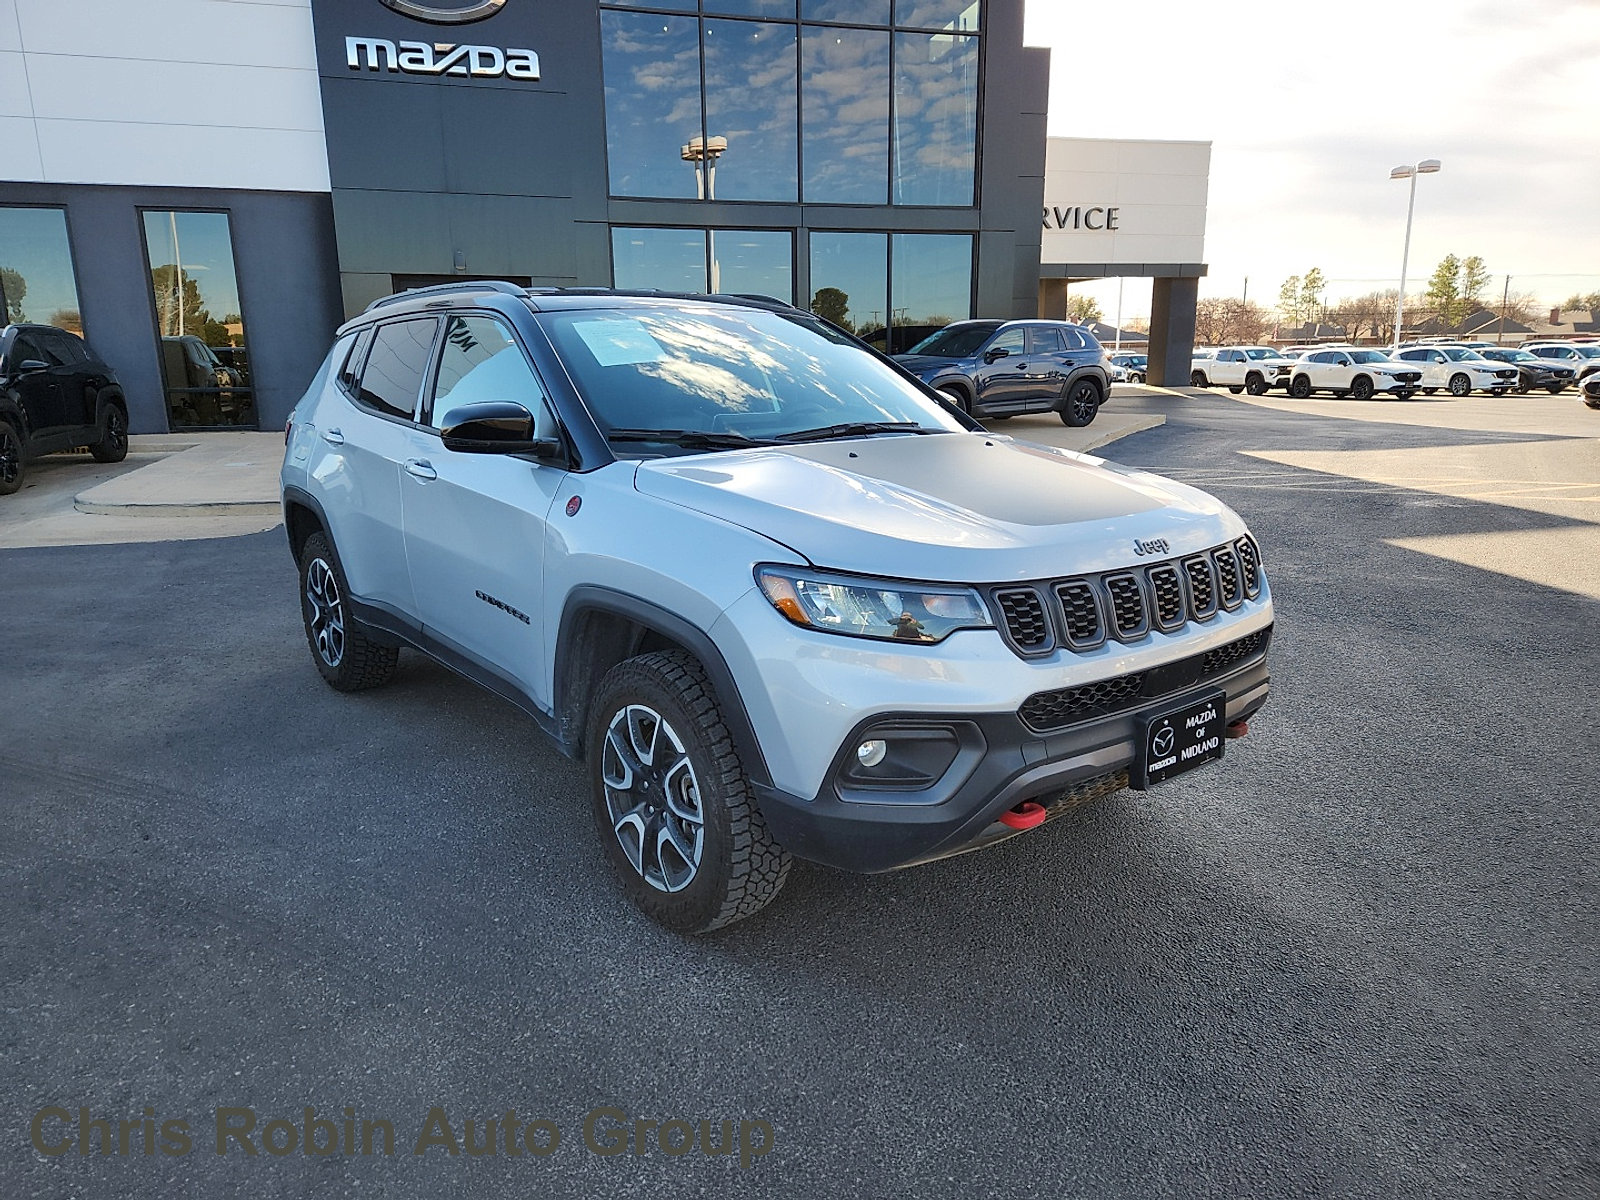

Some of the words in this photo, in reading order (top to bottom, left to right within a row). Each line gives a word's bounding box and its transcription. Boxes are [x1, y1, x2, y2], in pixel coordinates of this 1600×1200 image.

[1133, 538, 1170, 556] Jeep
[1185, 708, 1217, 730] MAZDA
[1195, 727, 1206, 738] OF
[1180, 736, 1219, 761] MIDLAND
